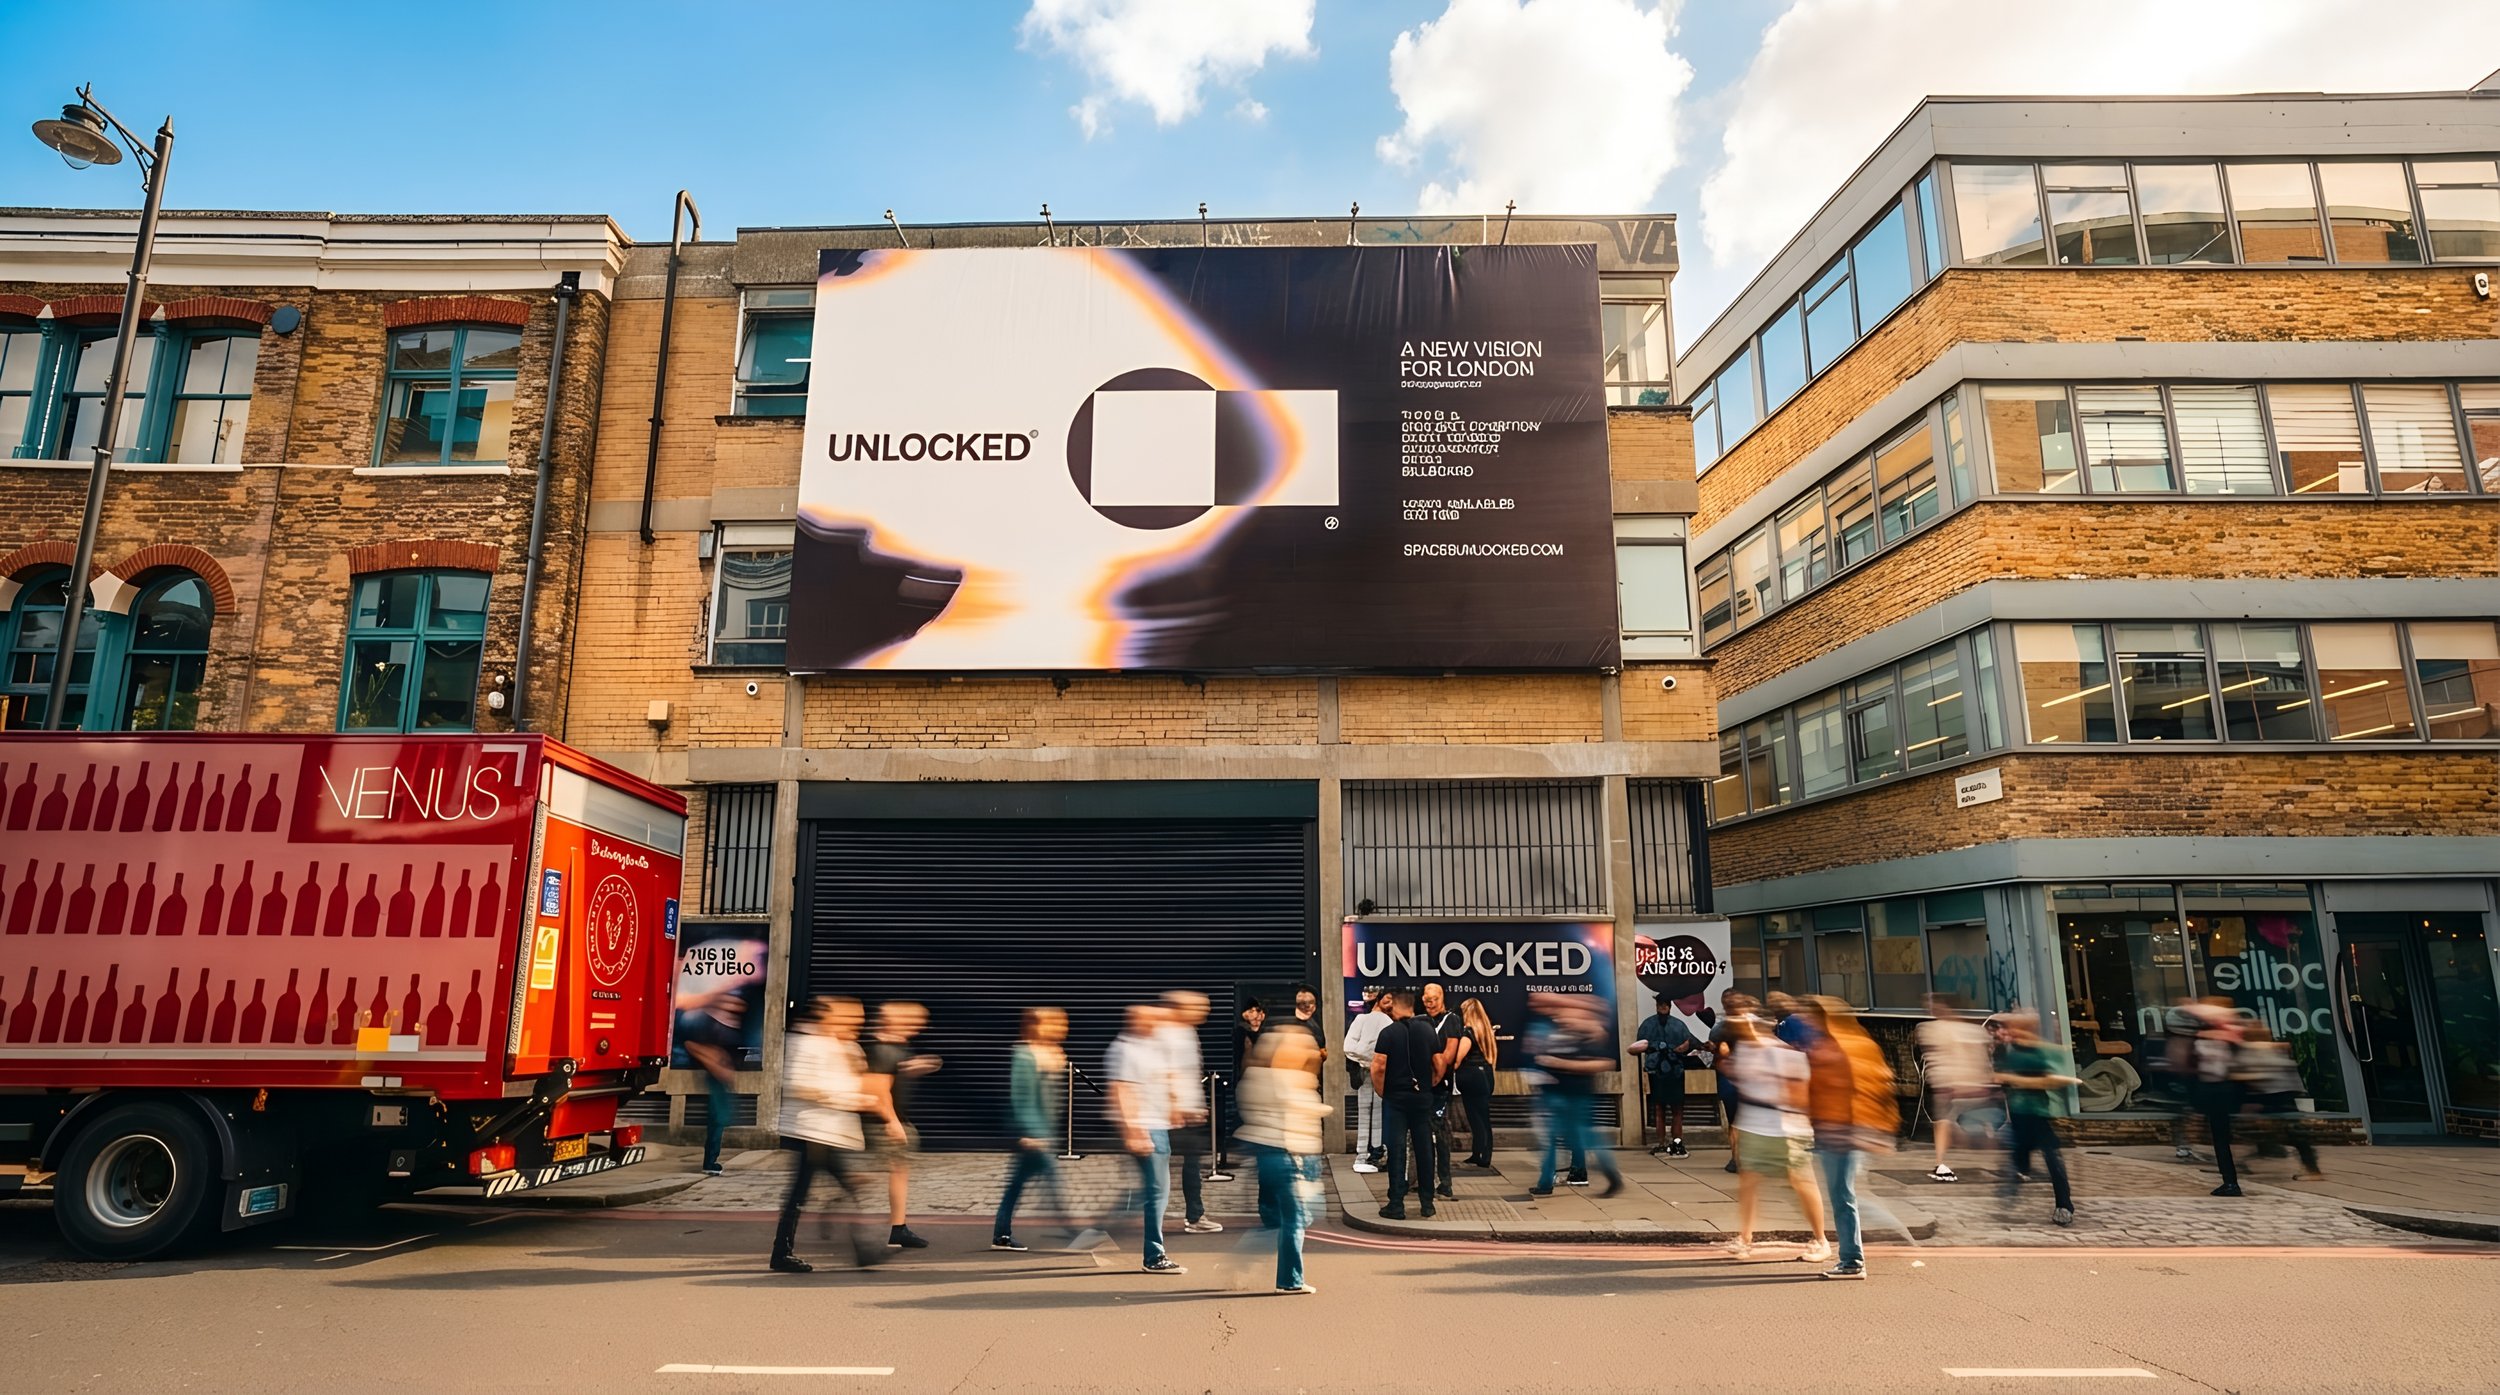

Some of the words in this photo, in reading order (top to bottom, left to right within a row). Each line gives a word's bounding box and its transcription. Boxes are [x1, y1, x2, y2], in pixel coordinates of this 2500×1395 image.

[1400, 341, 1415, 357] A
[1420, 341, 1469, 357] NEW
[1473, 340, 1542, 357] VISION
[1400, 360, 1442, 377] FOR
[1447, 360, 1534, 377] LONDON
[828, 432, 1032, 462] UNLOCKED
[319, 765, 502, 820] VENUS
[1356, 942, 1592, 977] UNLOCKED
